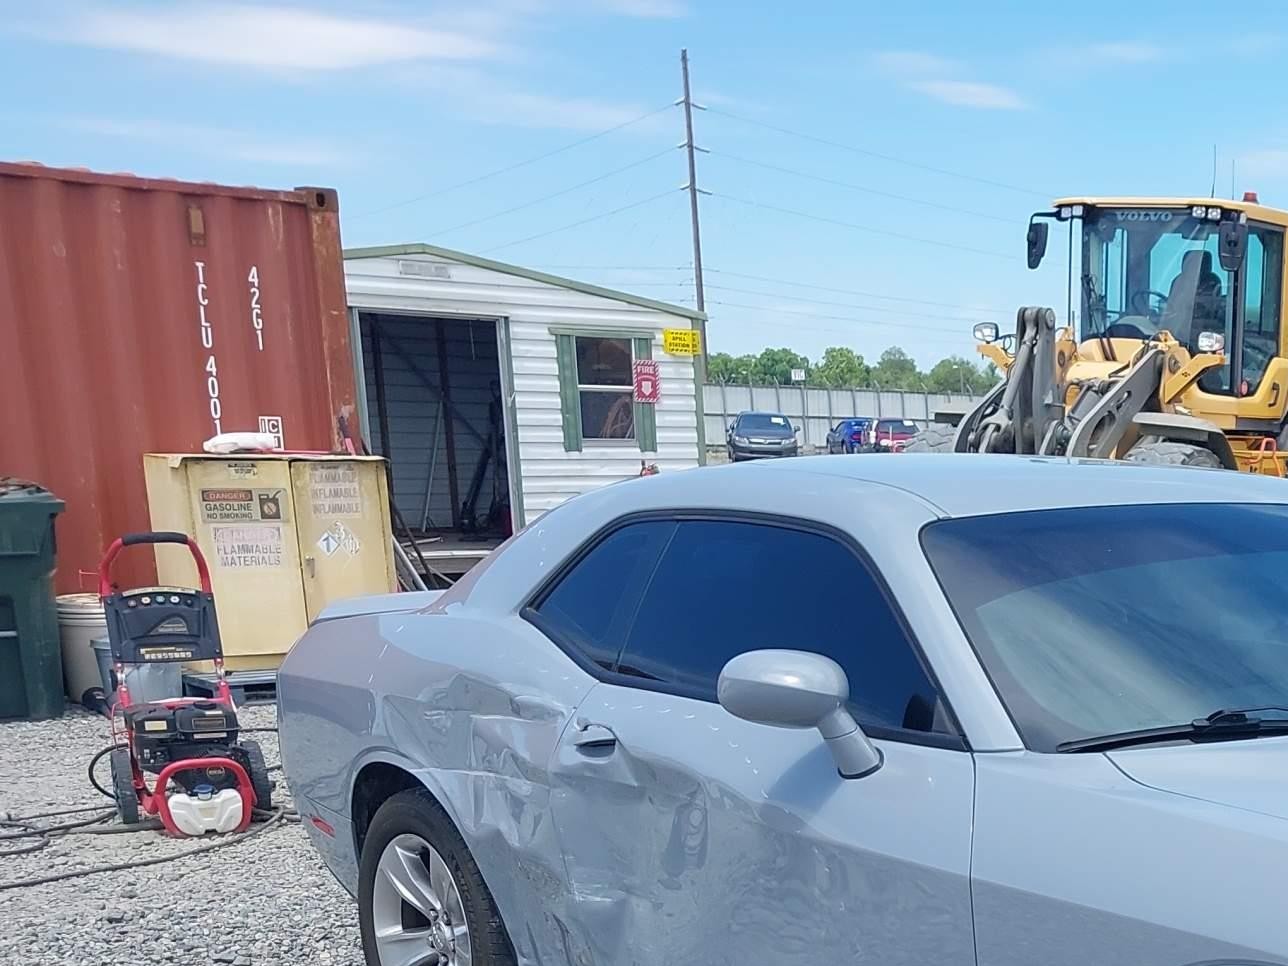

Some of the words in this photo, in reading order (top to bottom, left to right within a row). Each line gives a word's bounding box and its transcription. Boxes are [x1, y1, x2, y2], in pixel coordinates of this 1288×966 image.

[1115, 211, 1173, 221] VOLVO
[195, 261, 213, 348] TCLU
[248, 266, 264, 350] 42G1
[637, 365, 655, 373] FIRE
[205, 503, 253, 511] GASOLINE
[219, 511, 253, 519] SMOKING
[217, 543, 281, 555] FLAMMABLE
[221, 555, 281, 567] MATERIALS
